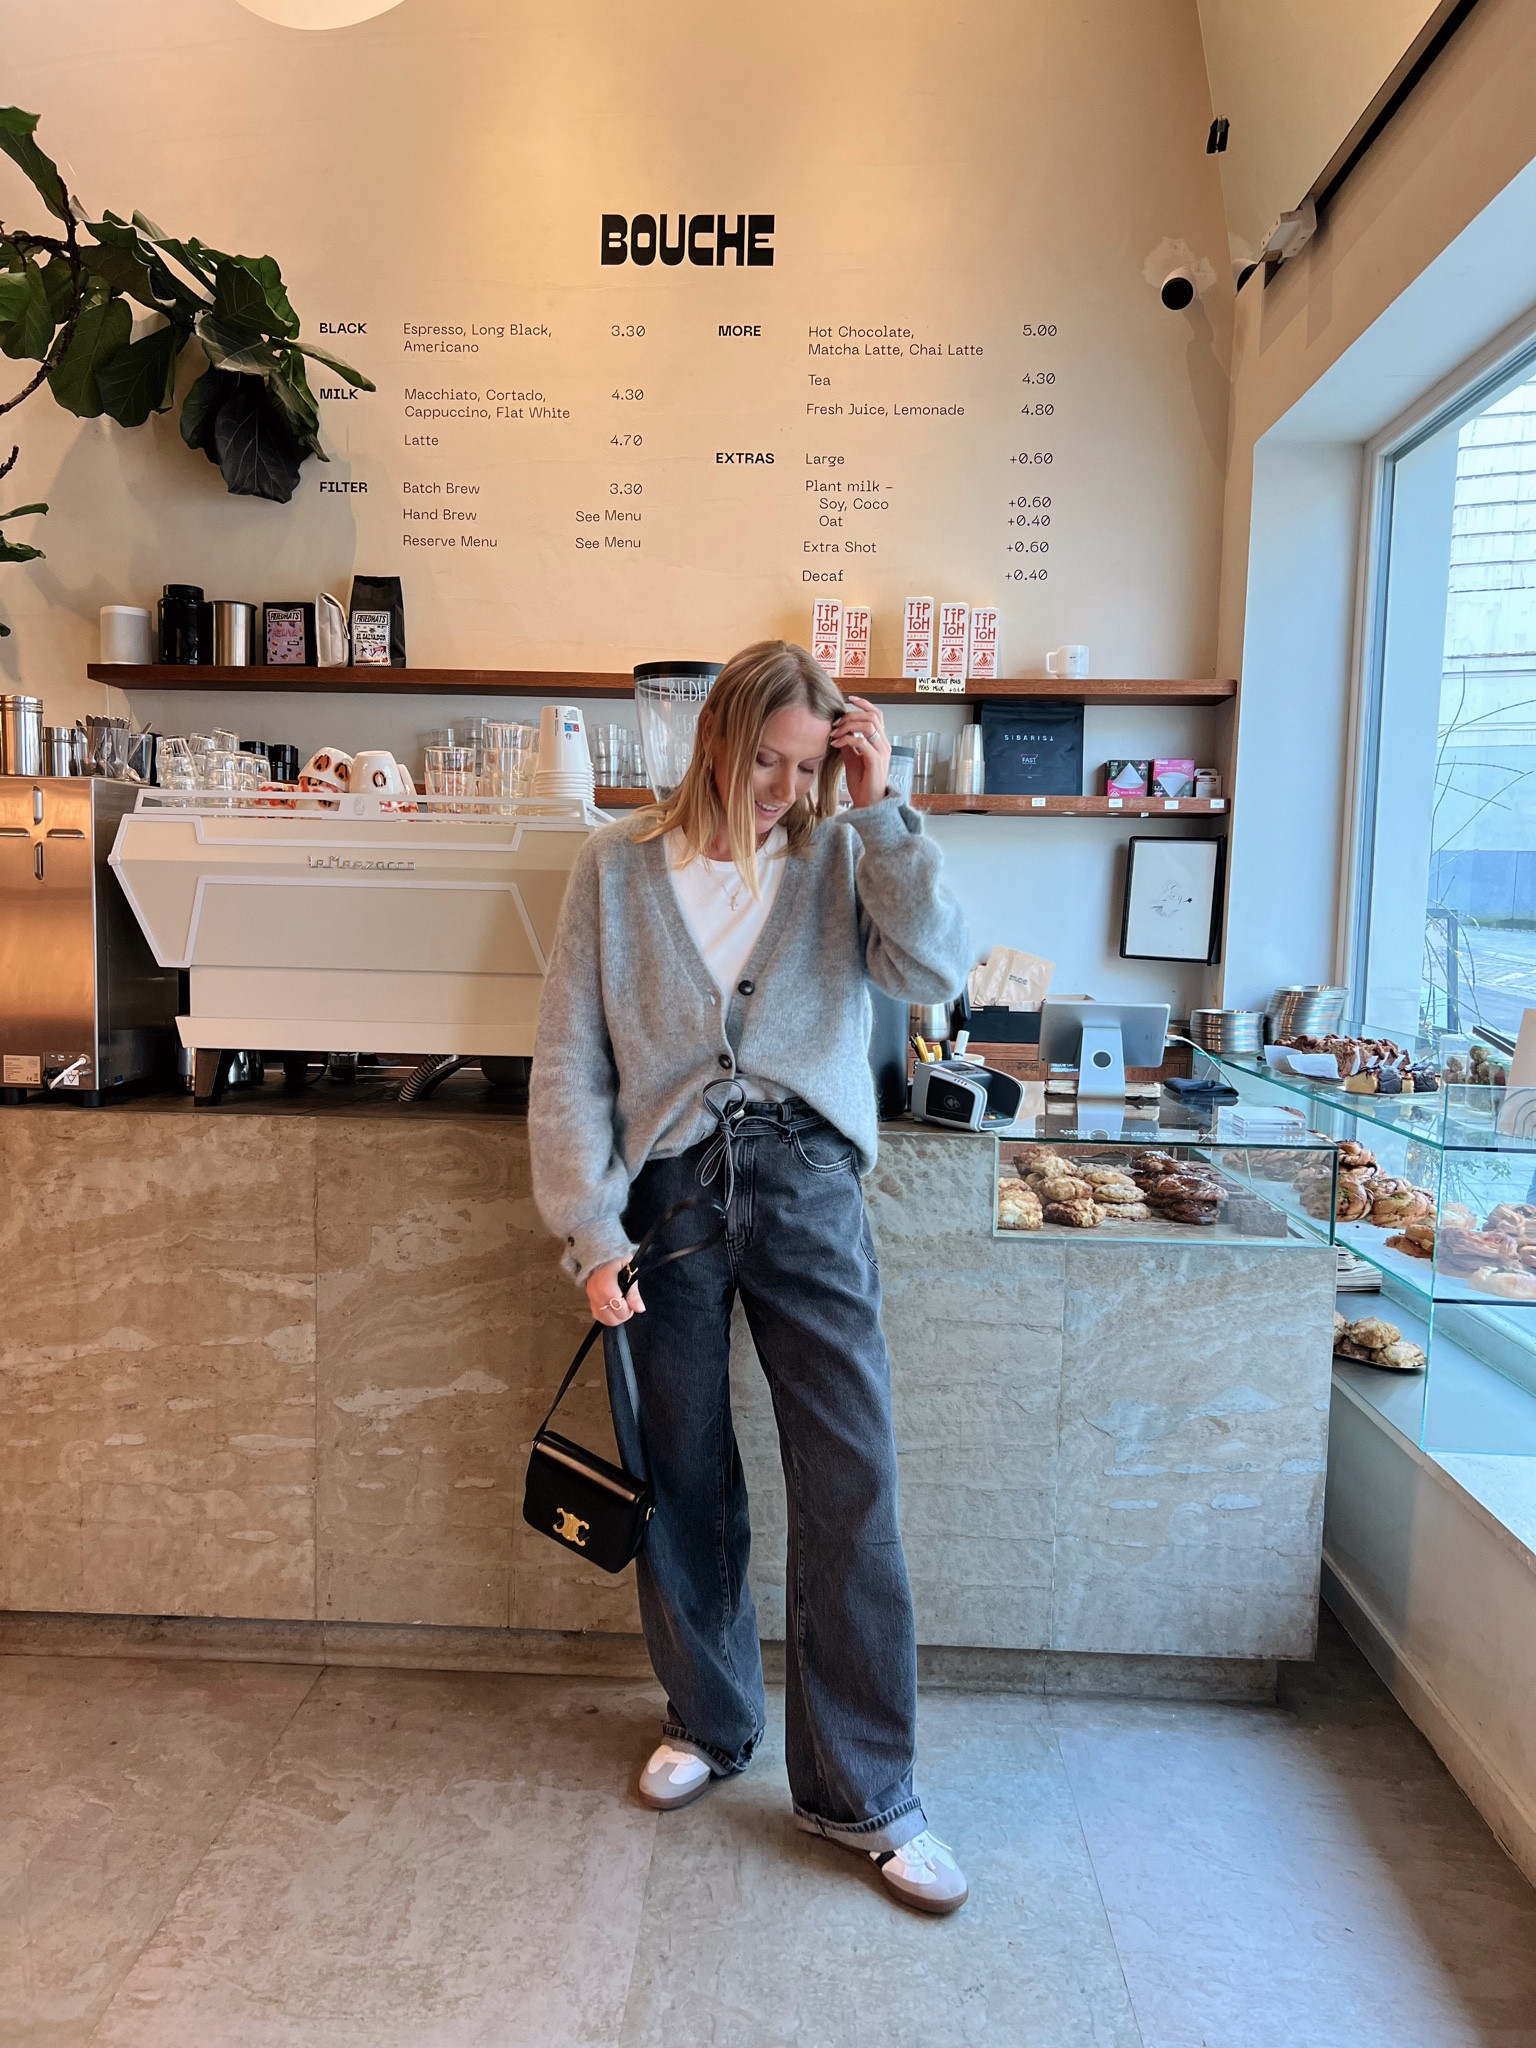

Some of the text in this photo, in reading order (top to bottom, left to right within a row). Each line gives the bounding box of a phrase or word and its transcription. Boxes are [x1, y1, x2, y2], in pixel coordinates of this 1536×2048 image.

[601, 214, 775, 266] BOUCHE
[319, 322, 368, 335] BLACK
[403, 322, 552, 339] Espresso, Long Black,
[611, 324, 646, 338] 3.30
[718, 324, 762, 337] MORE
[808, 324, 915, 340] Hot Chocolate,
[1022, 323, 1058, 337] 5.00
[403, 340, 480, 353] Americano
[808, 342, 984, 358] Matcha Latte, Chai Latte
[807, 373, 832, 386] Tea
[1021, 372, 1056, 385] 4.30
[319, 387, 359, 400] MILK
[404, 387, 546, 404] Macchiato, Cortado,
[611, 388, 645, 401] 4.30
[404, 405, 571, 421] Cappuccino, Flat White
[806, 402, 965, 418] Fresh Juice, Lemonade
[1020, 403, 1055, 416] 4.80
[404, 433, 439, 447] Latte
[609, 434, 643, 447] 4.70
[715, 452, 775, 465] EXTRAS
[805, 452, 845, 468] Large
[1009, 452, 1054, 465] +0.60
[319, 481, 368, 494] FILTER
[403, 481, 481, 495] Batch Brew
[609, 482, 643, 496] 3.30
[805, 479, 843, 493] Plant
[847, 479, 880, 493] milk
[818, 497, 890, 513] Soy, Coco
[1008, 495, 1052, 509] +0.60
[402, 507, 478, 521] Hand Brew
[575, 509, 642, 523] See Menu
[818, 514, 844, 528] Oat
[1007, 514, 1051, 527] +0.40
[402, 534, 498, 548] Reserve Menu
[574, 536, 641, 550] See Menu
[803, 540, 877, 554] Extra Shot
[1005, 540, 1050, 554] +0.60
[802, 569, 845, 582] Decaf
[1004, 568, 1048, 581] +0.40
[1004, 734, 1054, 742] SIBARIST
